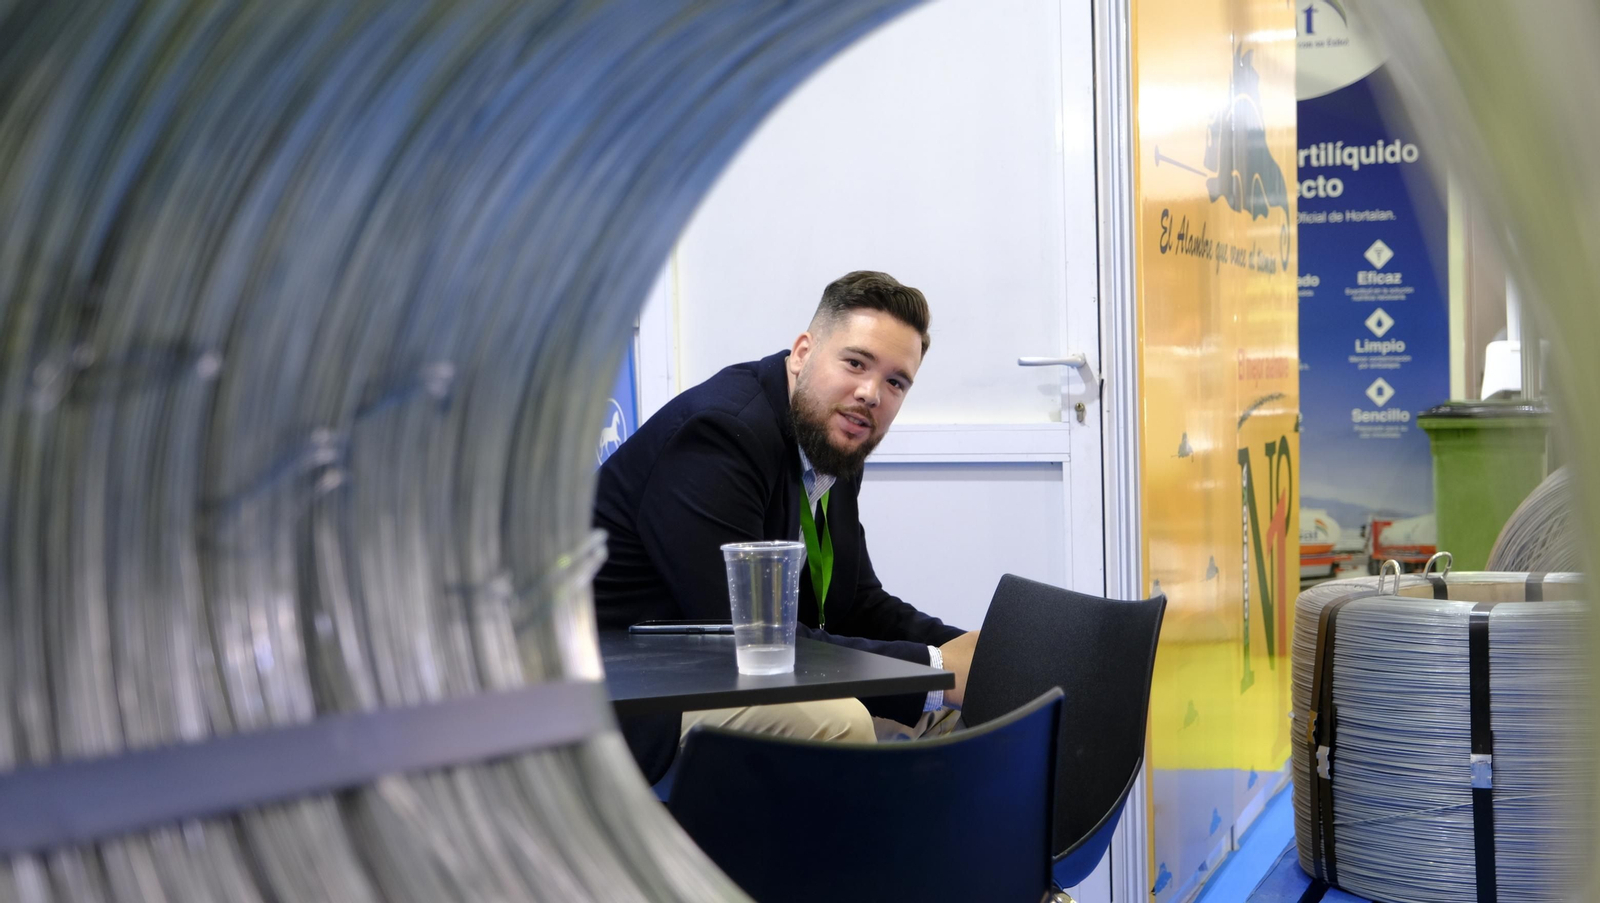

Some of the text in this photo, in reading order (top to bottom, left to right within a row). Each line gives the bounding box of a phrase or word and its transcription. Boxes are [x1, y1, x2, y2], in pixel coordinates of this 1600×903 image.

[1299, 4, 1319, 35] t
[1298, 139, 1419, 171] rtilíquido
[1328, 209, 1344, 224] de
[1159, 208, 1173, 254] El
[1175, 214, 1214, 261] Alambre
[1357, 271, 1402, 285] Eficaz
[1355, 338, 1406, 355] Limpio
[1351, 408, 1411, 423] Sencillo
